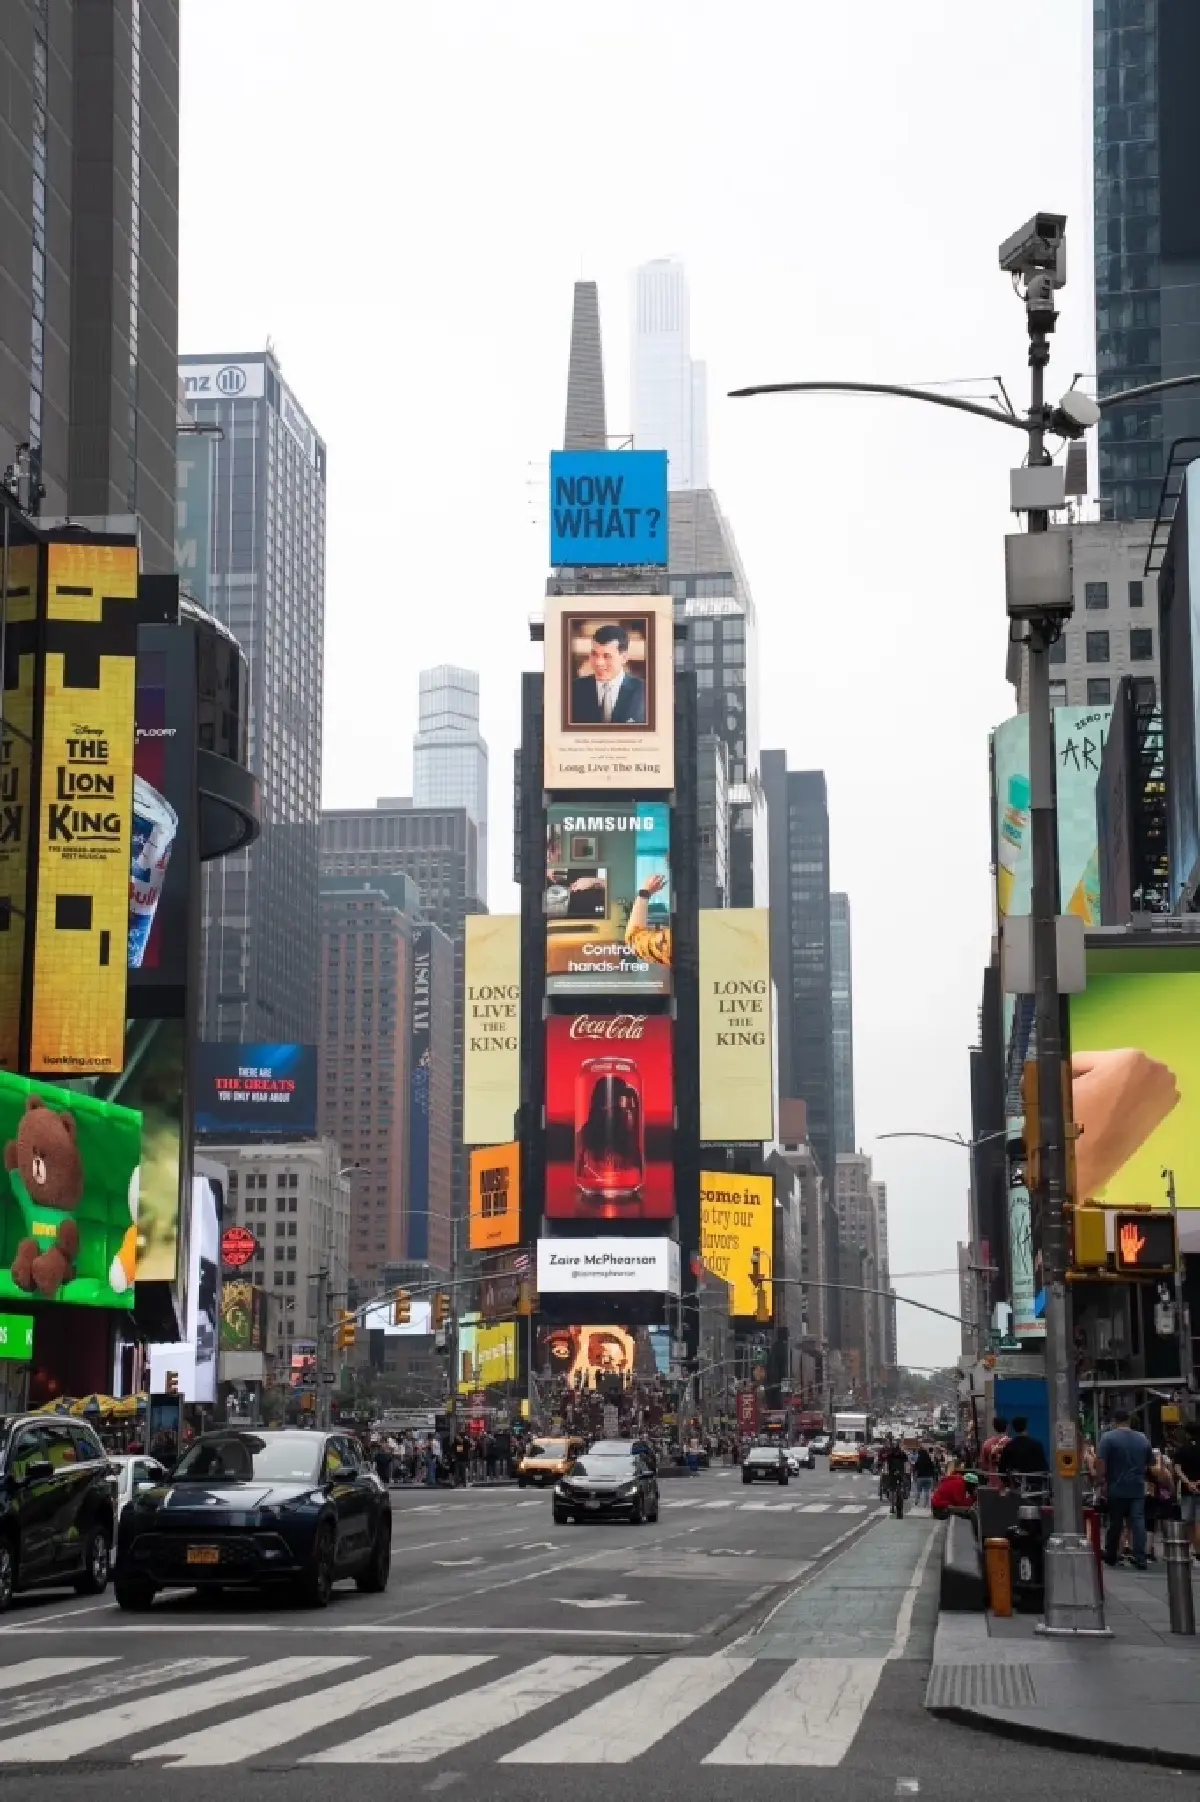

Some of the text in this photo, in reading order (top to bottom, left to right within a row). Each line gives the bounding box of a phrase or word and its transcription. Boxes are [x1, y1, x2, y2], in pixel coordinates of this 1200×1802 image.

[555, 475, 624, 506] NOW
[553, 508, 661, 538] WHAT?
[66, 739, 109, 758] THE
[560, 763, 661, 774] Long Live The King
[48, 803, 120, 843] KING
[563, 816, 654, 832] SAMSUNG
[567, 959, 649, 972] hands-free
[467, 985, 520, 1000] LONG
[713, 980, 766, 995] LONG
[472, 1004, 516, 1018] LIVE
[719, 999, 763, 1013] LIVE
[480, 1021, 506, 1032] THE
[569, 1013, 648, 1039] Coca-Cola
[728, 1016, 753, 1027] THE
[469, 1036, 518, 1052] KING
[715, 1031, 766, 1046] KING
[43, 1055, 111, 1066] lionking.com
[238, 1067, 272, 1078] THERE ARE
[215, 1078, 296, 1091] THE GREATS
[743, 1188, 761, 1206] in
[712, 1205, 731, 1230] try
[733, 1210, 754, 1227] our
[549, 1252, 657, 1265] Zaire McPhearson
